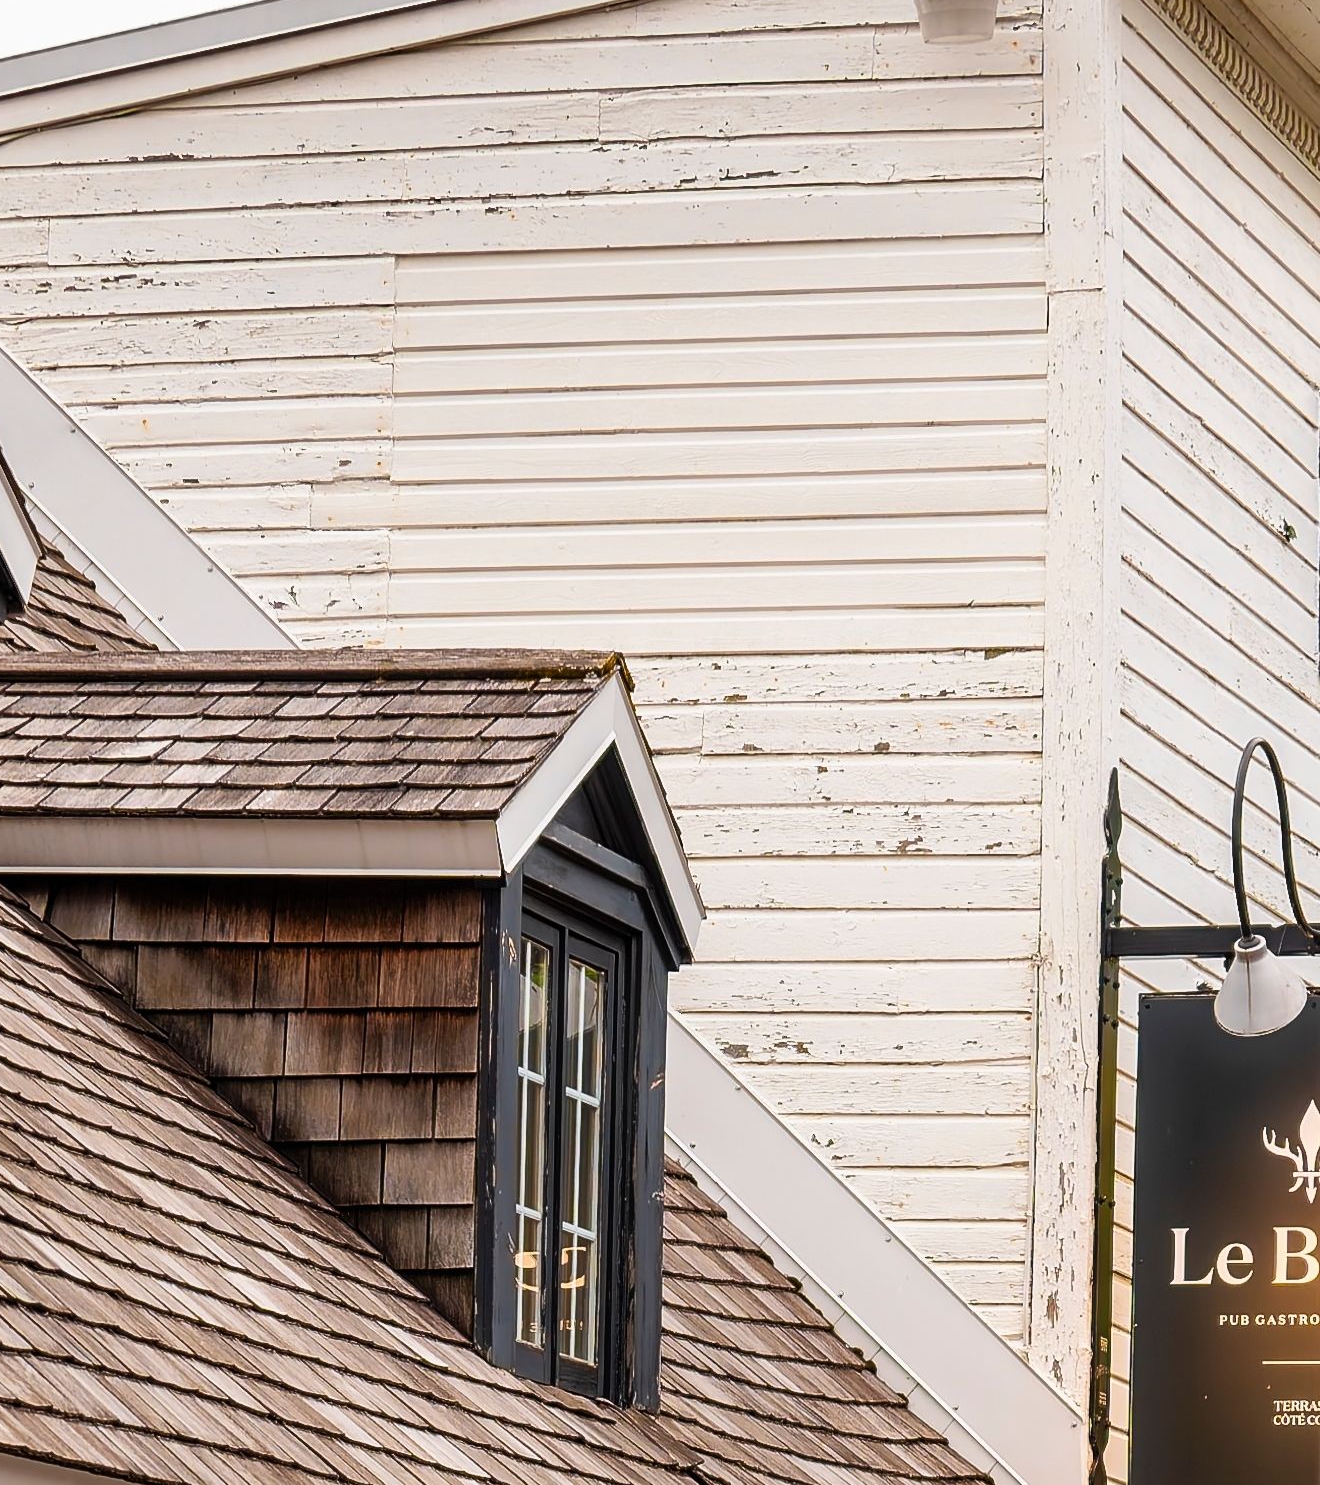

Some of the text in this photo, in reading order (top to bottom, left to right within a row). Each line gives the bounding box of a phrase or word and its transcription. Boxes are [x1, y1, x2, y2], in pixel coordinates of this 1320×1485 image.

[1170, 1227, 1254, 1286] Le
[1219, 1314, 1250, 1326] PUB
[1273, 1412, 1306, 1426] CÔTÉ
